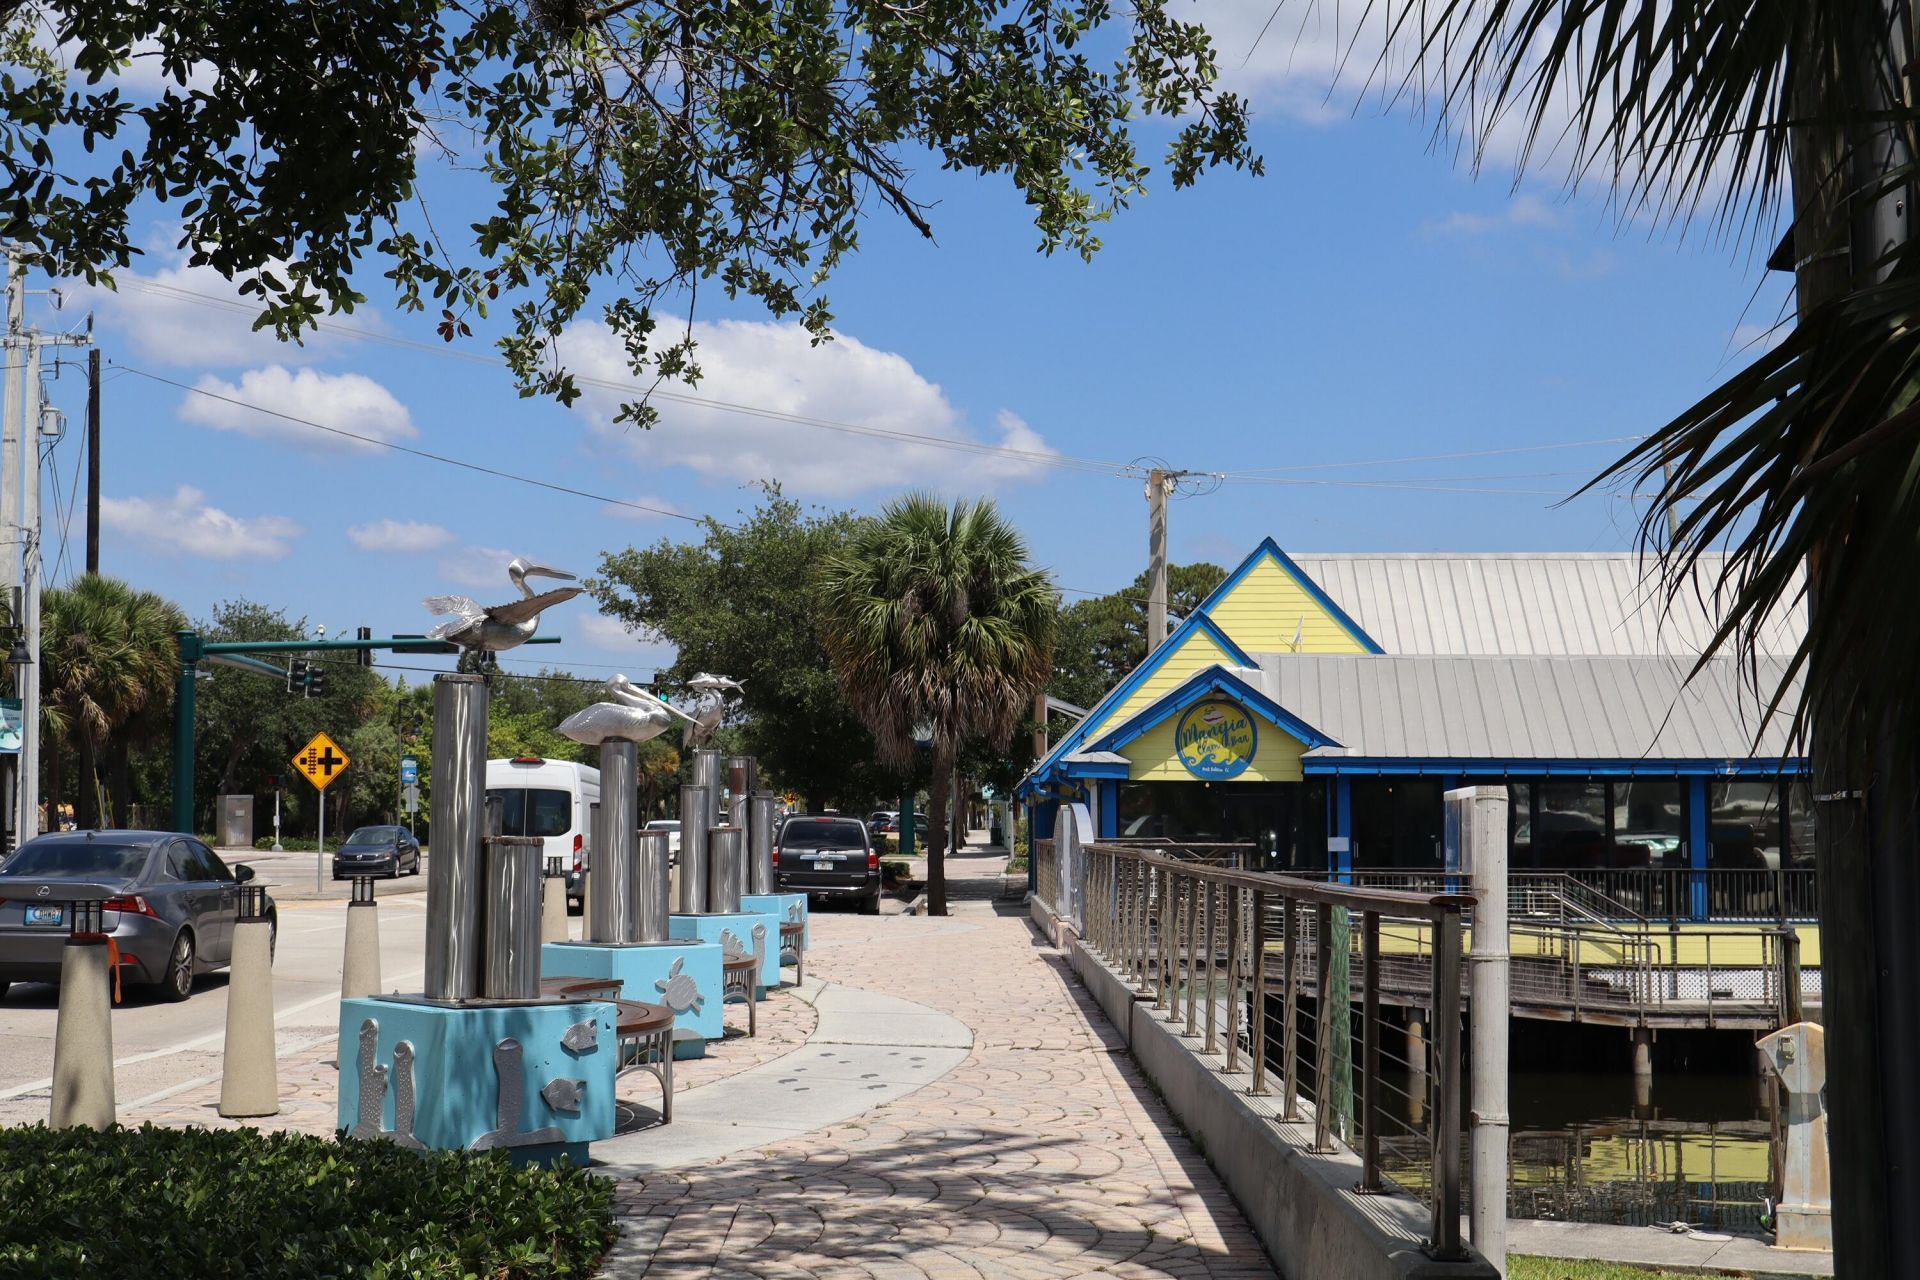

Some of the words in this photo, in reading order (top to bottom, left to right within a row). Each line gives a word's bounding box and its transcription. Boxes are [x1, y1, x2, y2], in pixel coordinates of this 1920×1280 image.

[1183, 719, 1247, 747] Mangia
[1197, 739, 1221, 755] Clam
[1231, 735, 1249, 746] Bar
